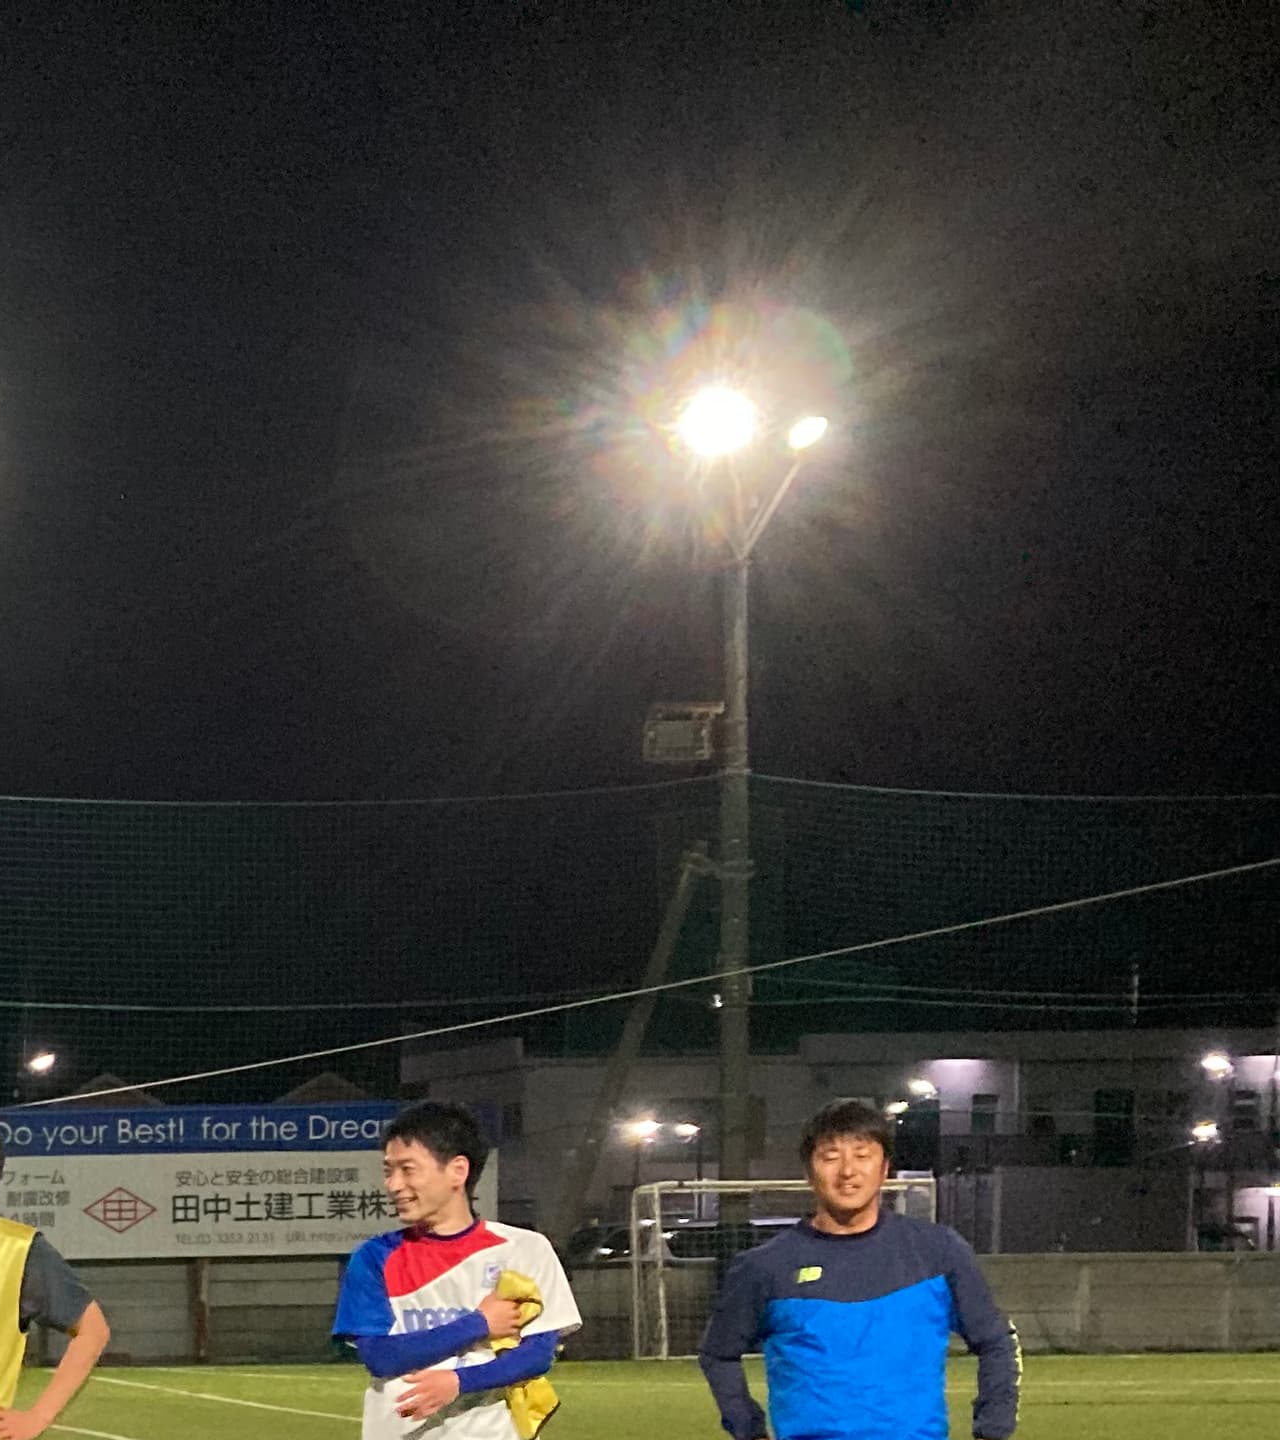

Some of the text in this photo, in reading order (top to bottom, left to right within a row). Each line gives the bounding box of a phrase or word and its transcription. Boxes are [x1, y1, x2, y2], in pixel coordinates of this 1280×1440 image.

[43, 1125, 108, 1150] your
[118, 1117, 184, 1144] Best!
[202, 1116, 240, 1141] for
[250, 1115, 298, 1140] the
[171, 1190, 400, 1224] 田中土建工業株
